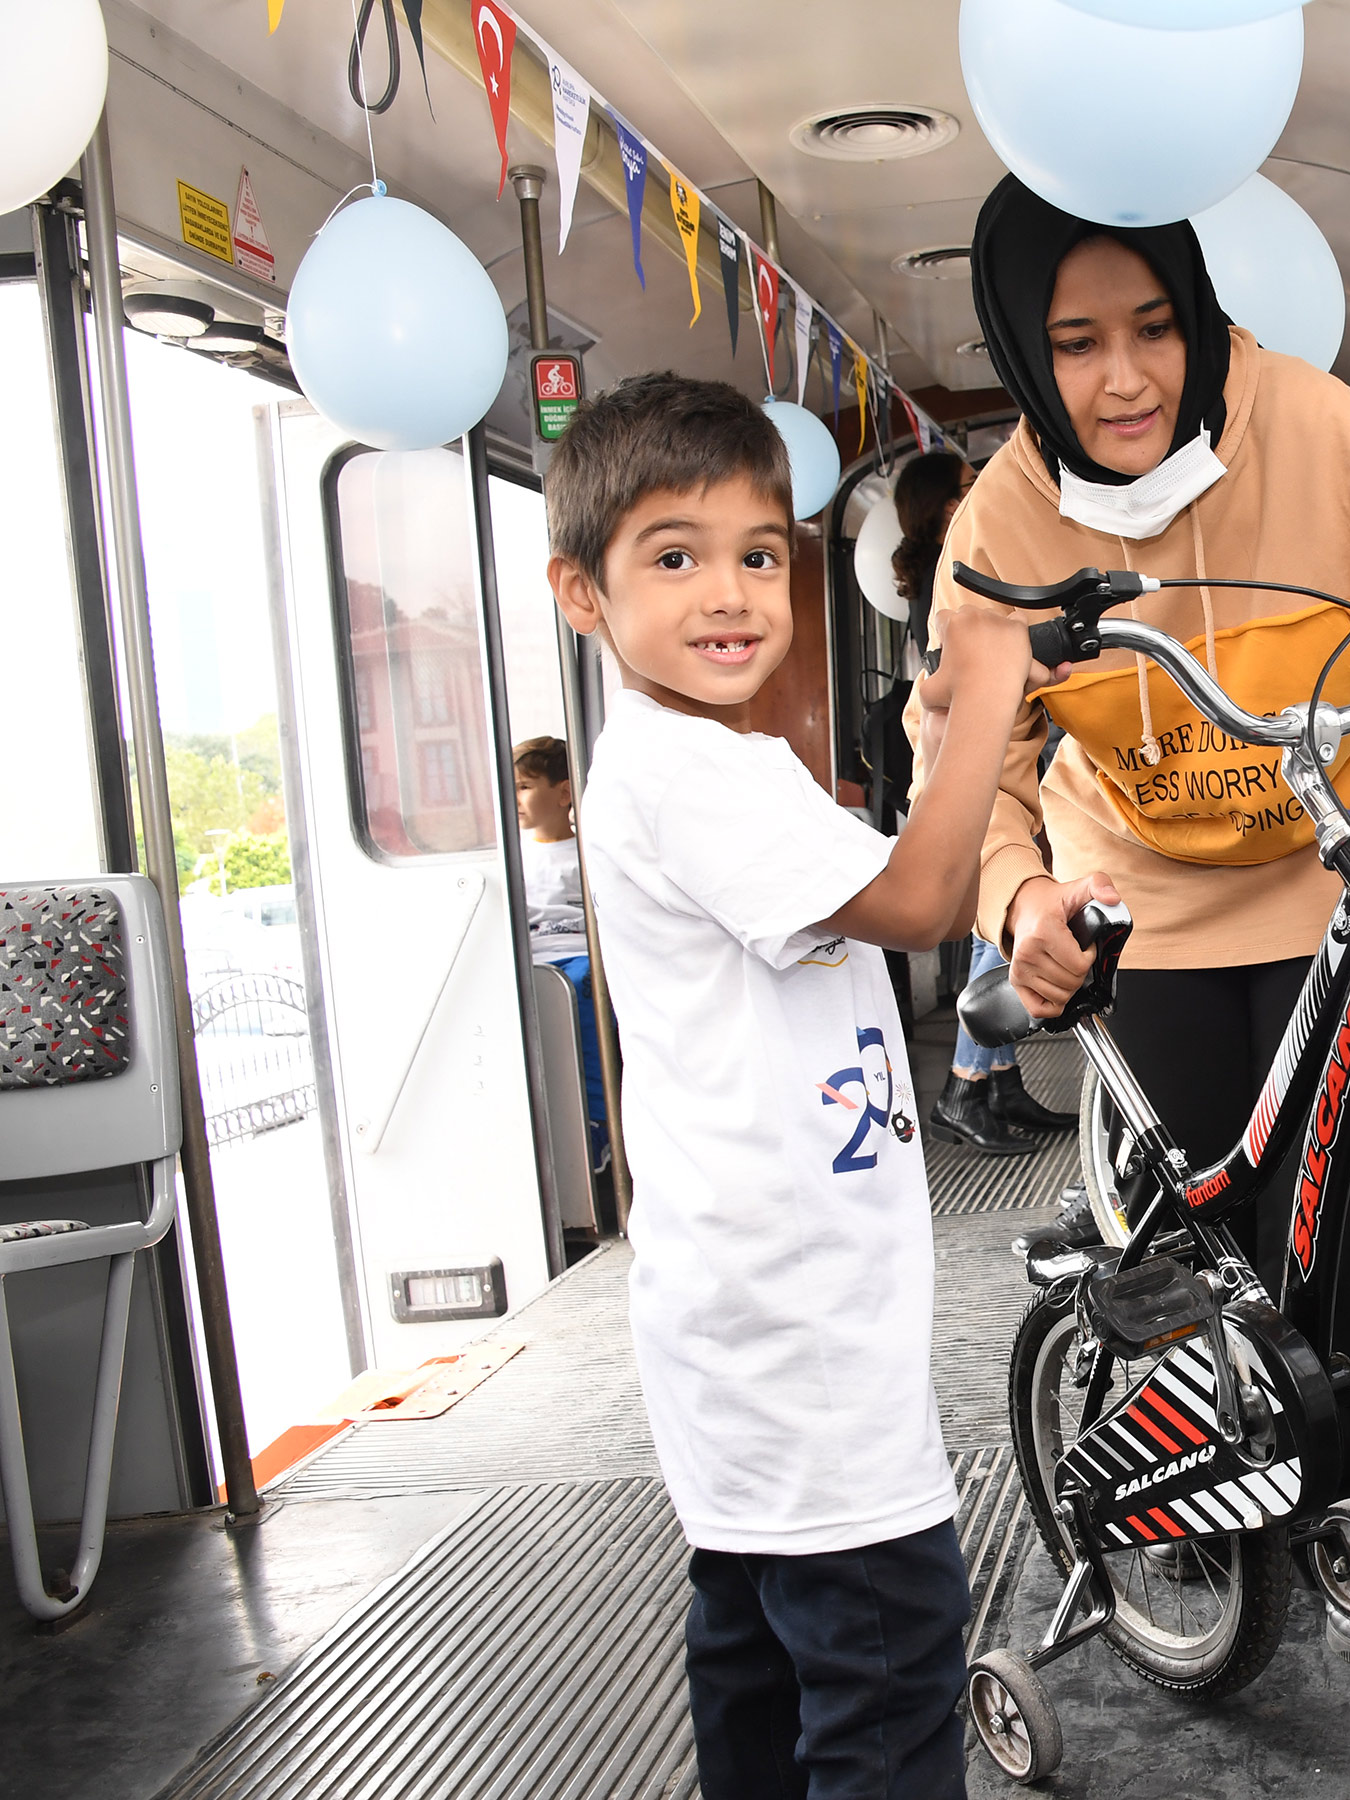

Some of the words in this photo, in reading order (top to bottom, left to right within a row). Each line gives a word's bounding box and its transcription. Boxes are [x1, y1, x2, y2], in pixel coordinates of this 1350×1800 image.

[1185, 760, 1280, 802] WORRY
[1185, 1168, 1232, 1208] fantom
[1115, 1445, 1217, 1502] SALCANO
